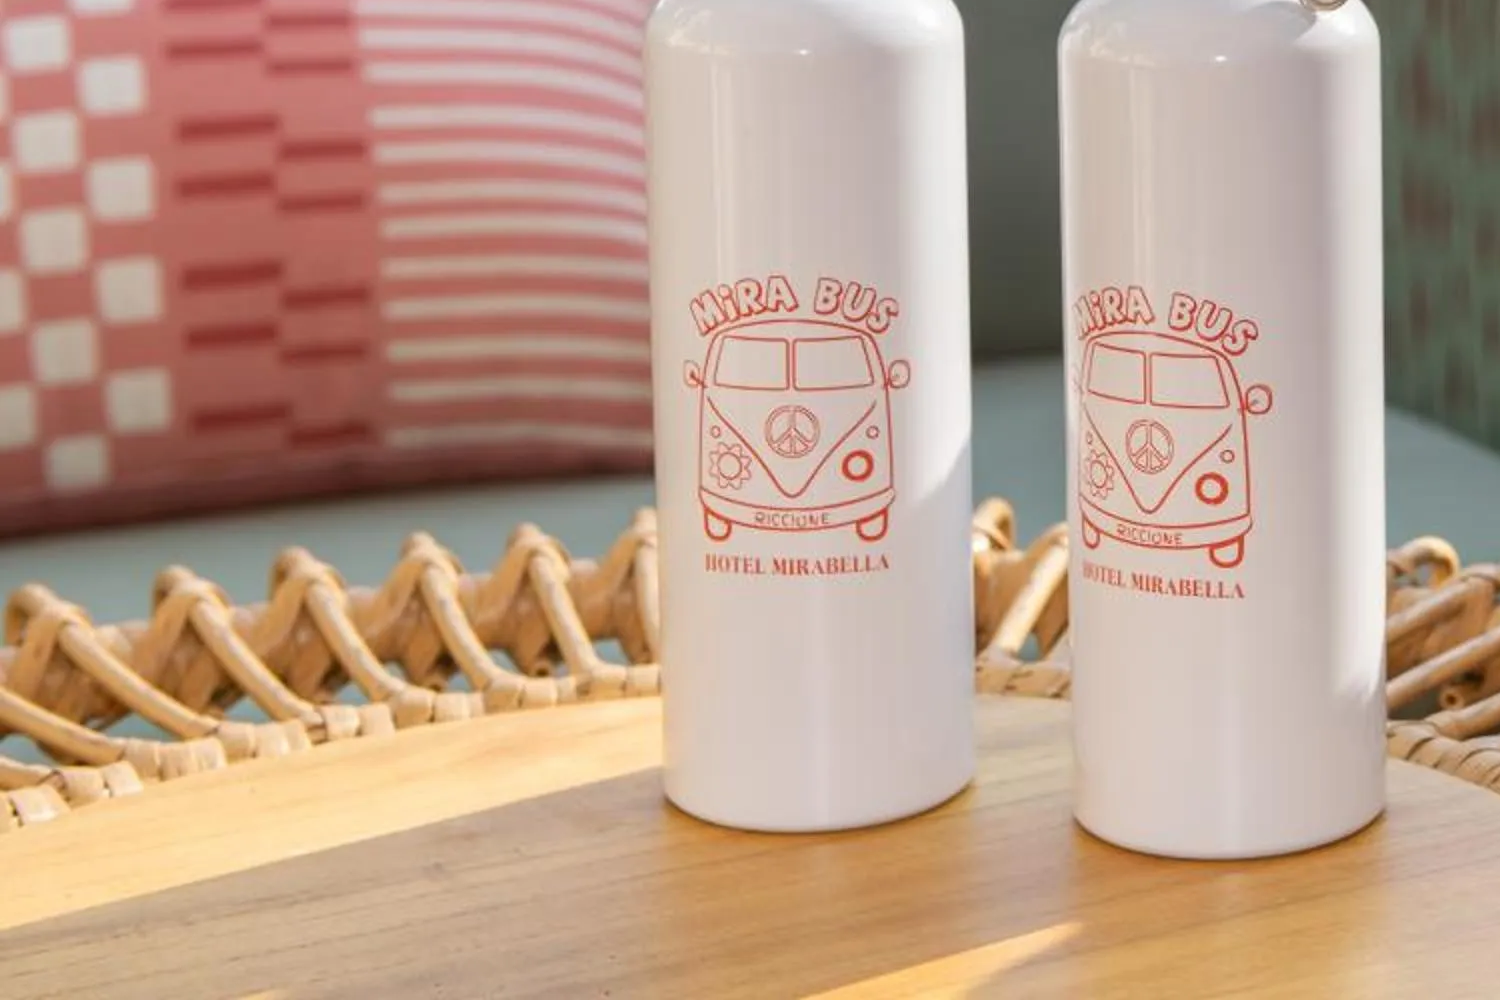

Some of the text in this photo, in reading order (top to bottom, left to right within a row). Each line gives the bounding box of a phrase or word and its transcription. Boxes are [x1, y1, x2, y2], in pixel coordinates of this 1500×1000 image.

[814, 277, 899, 334] BUS
[1168, 292, 1259, 356] BUS
[754, 511, 831, 528] RICCIONE
[1116, 524, 1183, 545] RICCIONE
[704, 553, 889, 577] HOTEL MIRABELLA
[1082, 560, 1245, 599] HOTEL MIRABELLA
